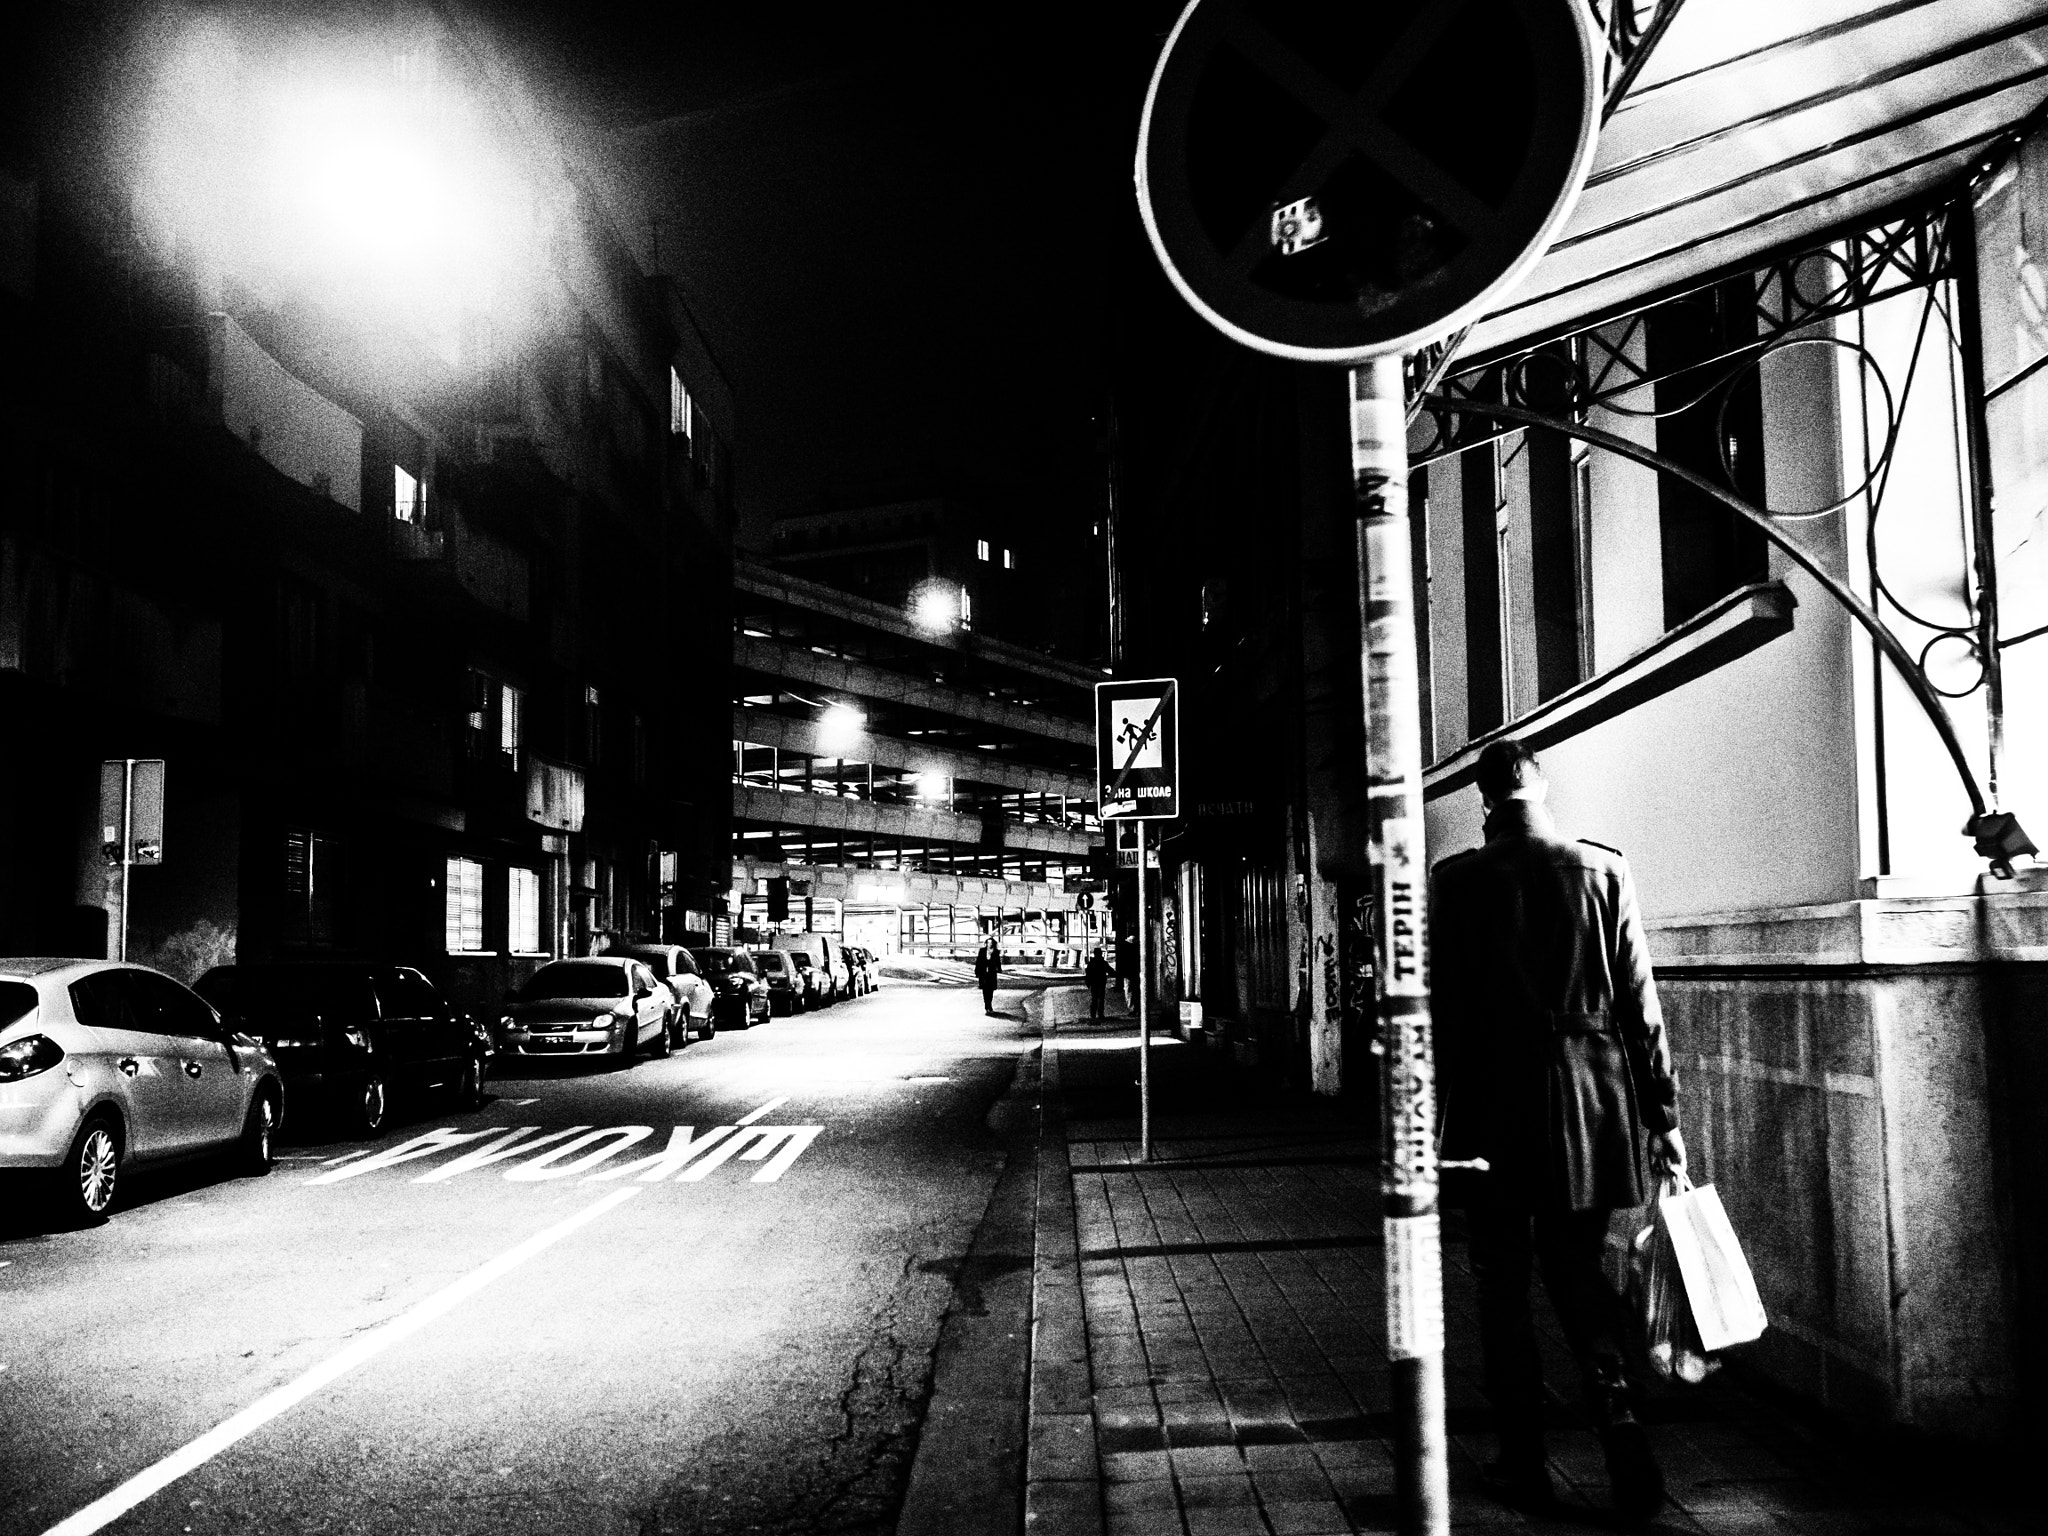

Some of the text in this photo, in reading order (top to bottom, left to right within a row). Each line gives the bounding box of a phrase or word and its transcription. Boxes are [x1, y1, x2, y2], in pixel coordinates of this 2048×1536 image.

[1105, 785, 1172, 798] Зна школе
[303, 1125, 824, 1185] ШКОЛА
